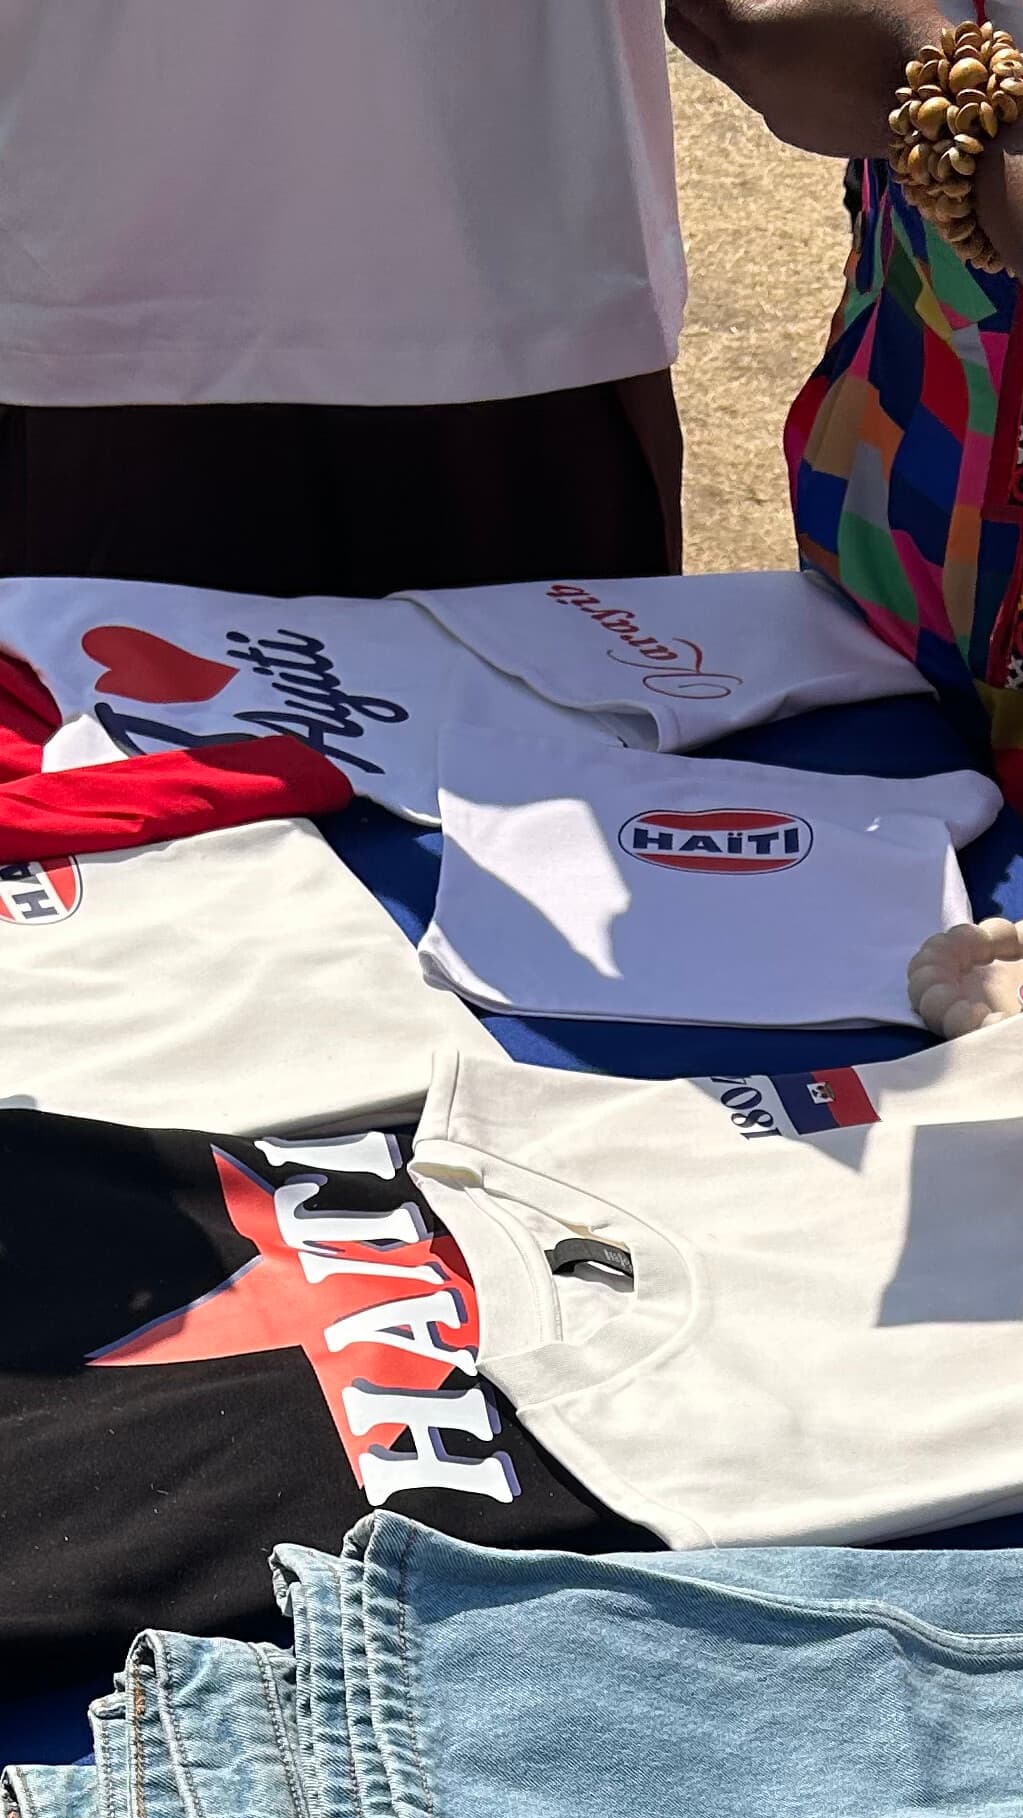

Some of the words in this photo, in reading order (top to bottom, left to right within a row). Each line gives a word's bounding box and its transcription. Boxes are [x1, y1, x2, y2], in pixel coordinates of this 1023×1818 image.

[226, 629, 409, 774] Ayiti
[631, 825, 800, 857] HAÏTI
[254, 1130, 521, 1507] HAITI
